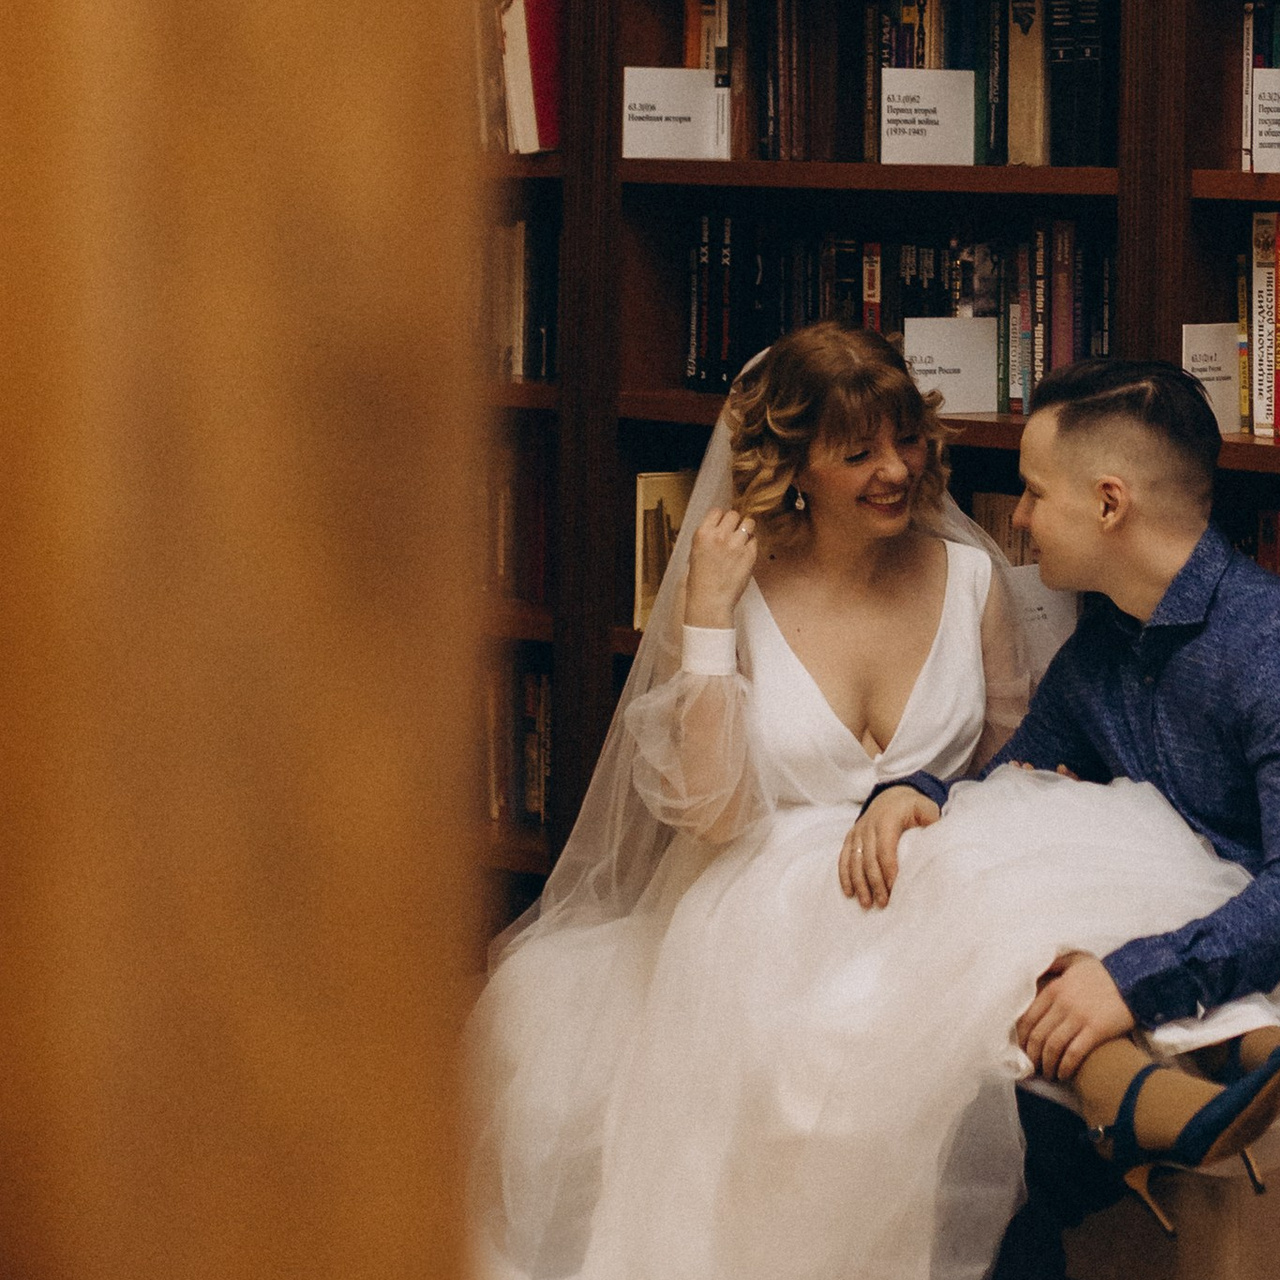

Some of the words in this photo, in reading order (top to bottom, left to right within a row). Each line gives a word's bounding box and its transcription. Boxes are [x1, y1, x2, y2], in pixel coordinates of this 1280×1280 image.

[887, 104, 913, 116] Период
[914, 105, 937, 117] второй
[628, 113, 663, 122] Новейшая
[665, 114, 692, 124] история
[887, 117, 916, 127] мировой
[918, 117, 940, 127] войны
[886, 127, 928, 138] (1939-1945)
[699, 246, 709, 263] XX
[721, 248, 731, 266] XX
[938, 366, 961, 375] России
